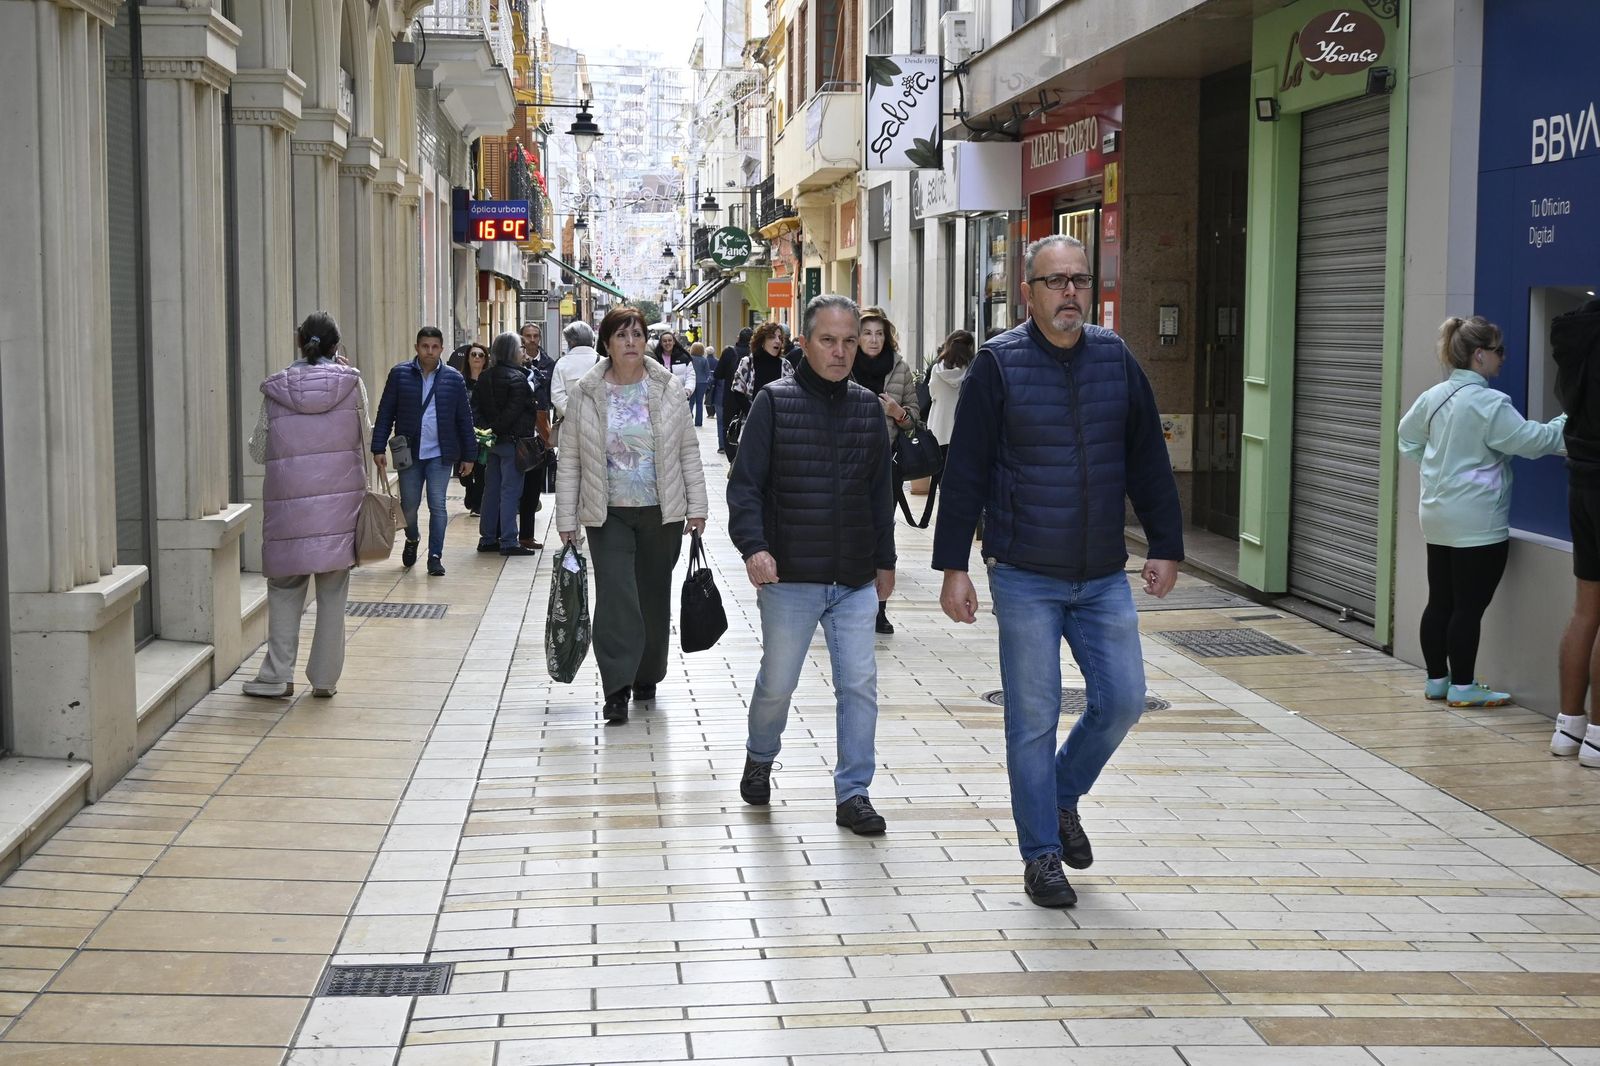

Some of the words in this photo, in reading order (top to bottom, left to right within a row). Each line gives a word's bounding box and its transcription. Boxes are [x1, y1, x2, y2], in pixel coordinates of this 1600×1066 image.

[1325, 12, 1356, 33] La
[1305, 40, 1378, 63] Ybense
[1030, 131, 1059, 169] MARIA
[1063, 115, 1098, 159] PRIETO
[1531, 102, 1600, 165] BBVA
[471, 205, 497, 214] óptica
[497, 205, 526, 213] urbano
[1530, 199, 1540, 218] Tu
[1541, 197, 1570, 217] Oficina
[479, 220, 496, 240] 16
[1529, 225, 1555, 248] Digital
